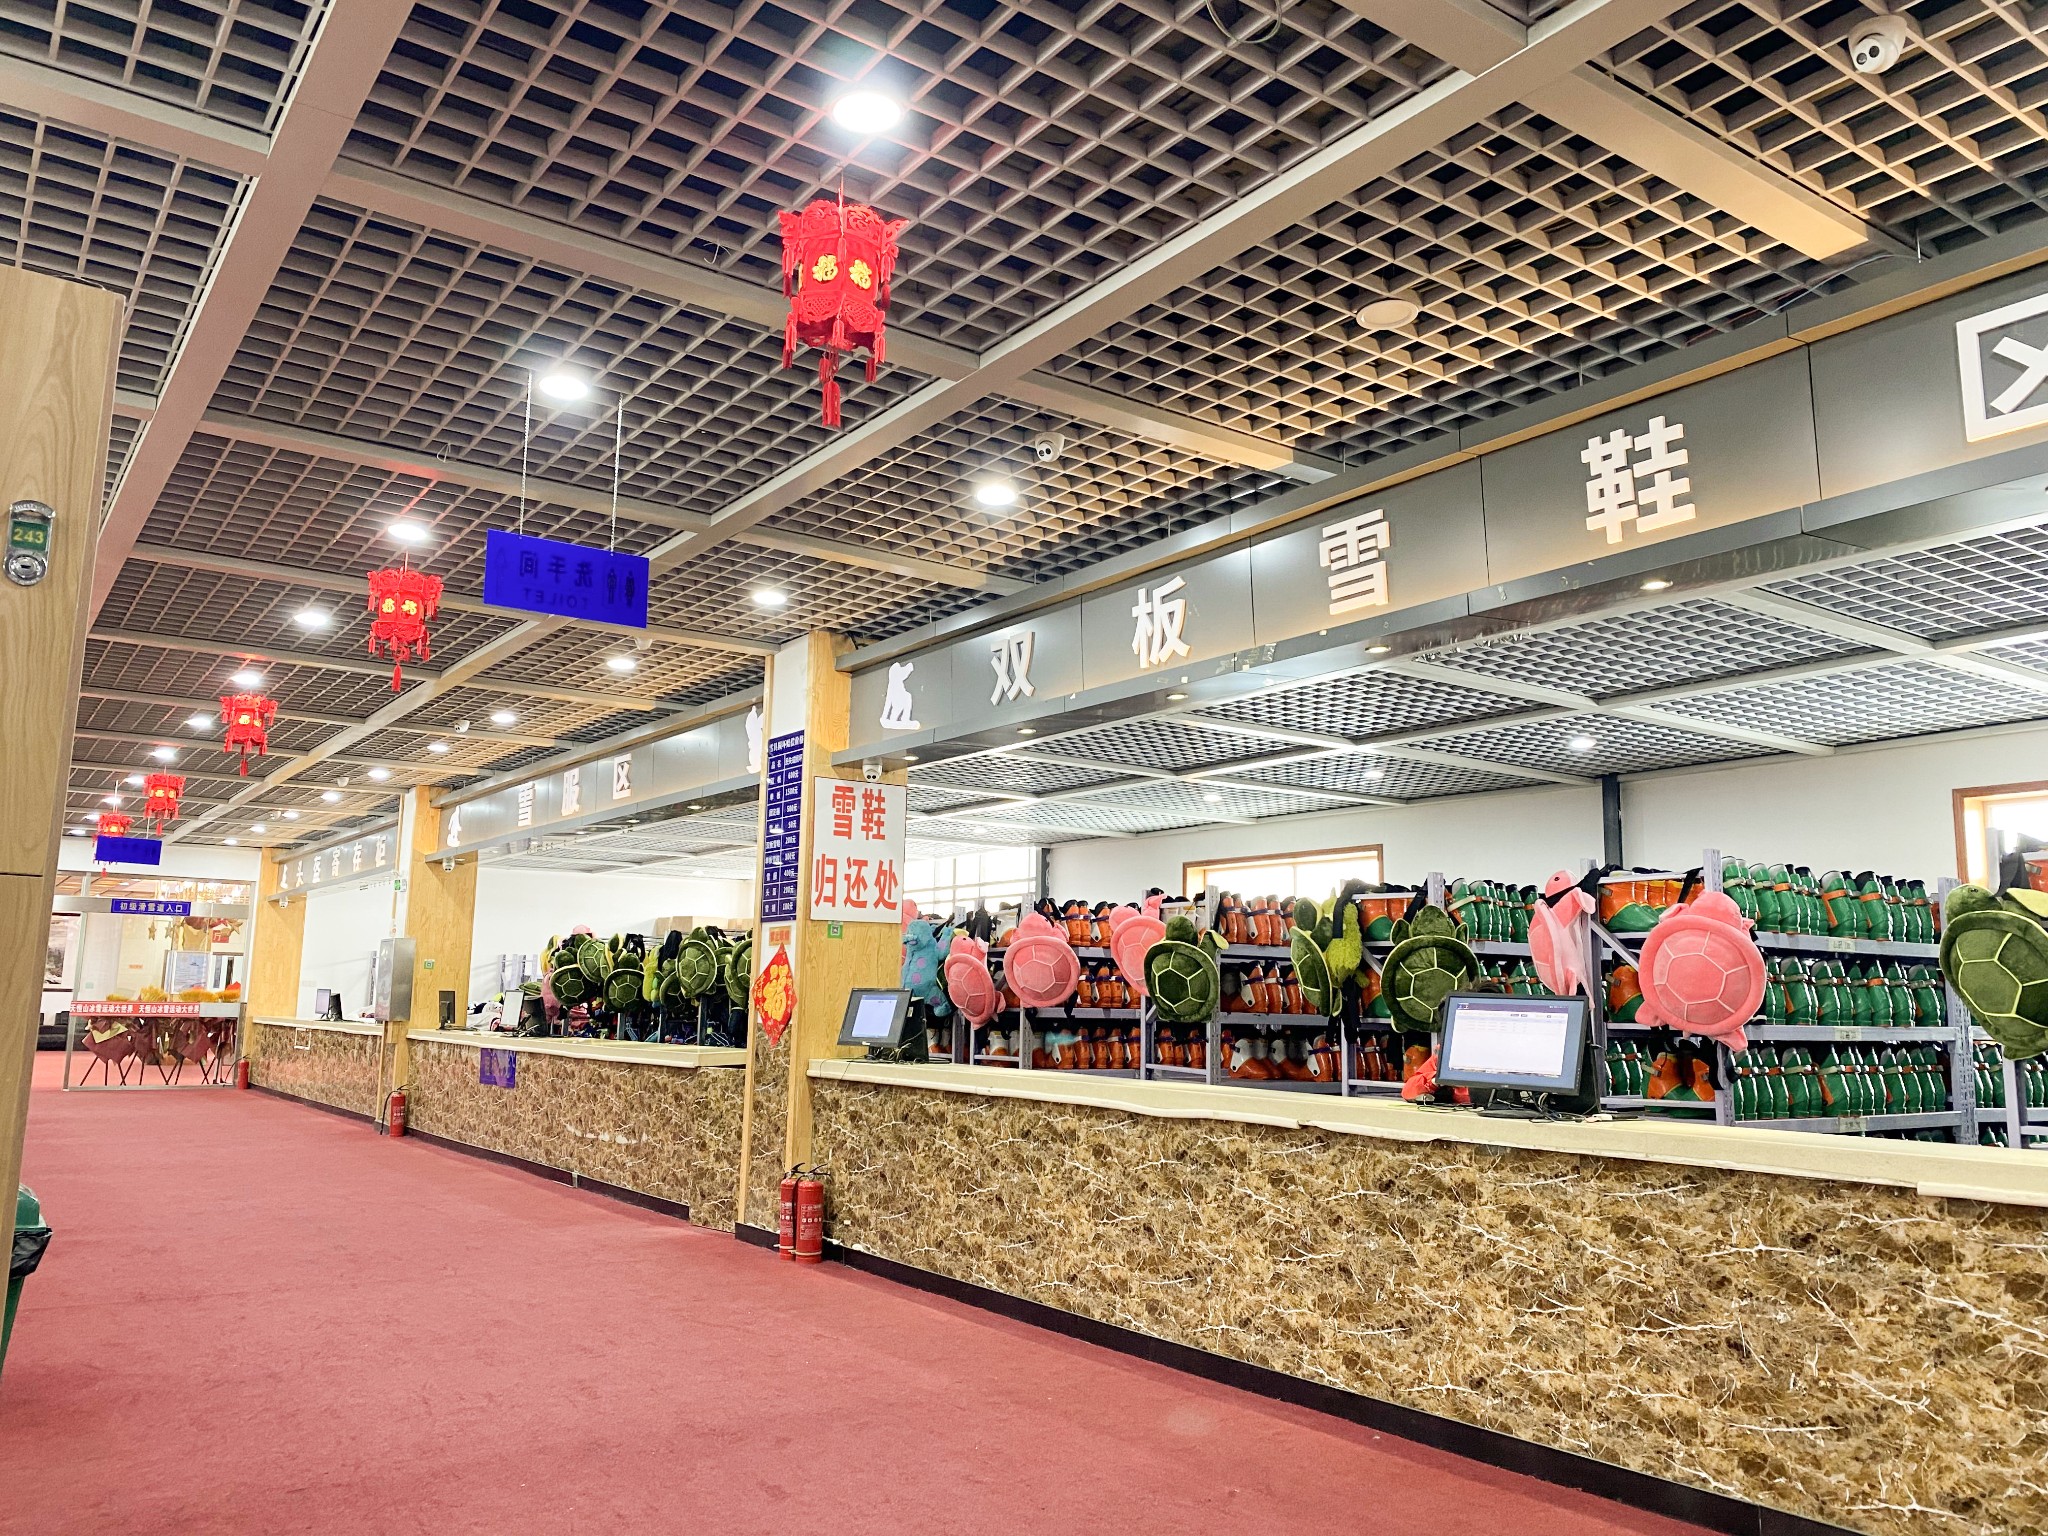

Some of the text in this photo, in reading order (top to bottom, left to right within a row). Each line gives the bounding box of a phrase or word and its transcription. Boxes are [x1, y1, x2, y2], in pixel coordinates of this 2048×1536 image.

[989, 291, 2048, 708] 双板雪鞋区
[13, 528, 44, 544] 243
[517, 753, 633, 828] 雪服区
[831, 785, 886, 841] 雪鞋
[814, 853, 899, 911] 归还处
